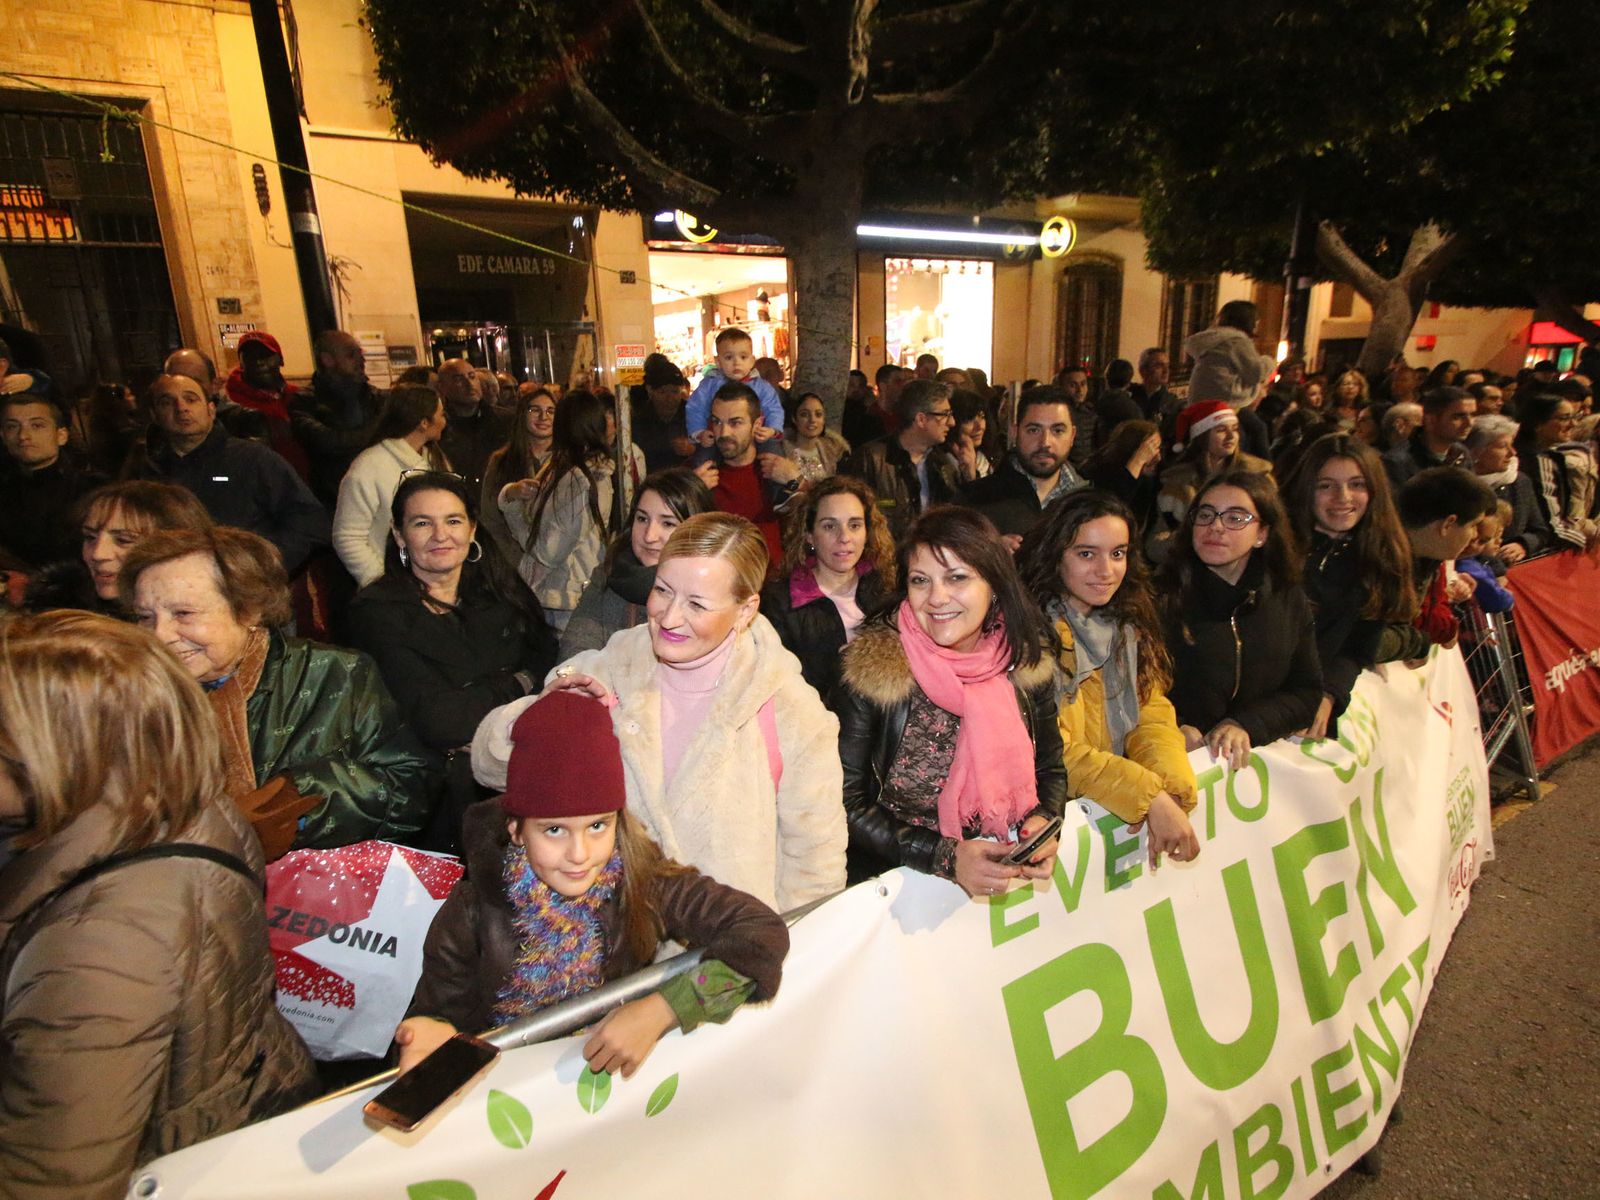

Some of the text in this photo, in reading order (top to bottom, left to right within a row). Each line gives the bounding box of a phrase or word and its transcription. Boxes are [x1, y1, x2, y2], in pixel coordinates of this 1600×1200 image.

[220, 299, 239, 314] 57
[487, 255, 540, 274] CAMARA
[543, 258, 556, 275] 59
[989, 750, 1269, 948] EVETO
[269, 905, 398, 958] ZEDONIA
[1001, 767, 1418, 1200] BUEN
[1152, 934, 1431, 1200] MBIENT
